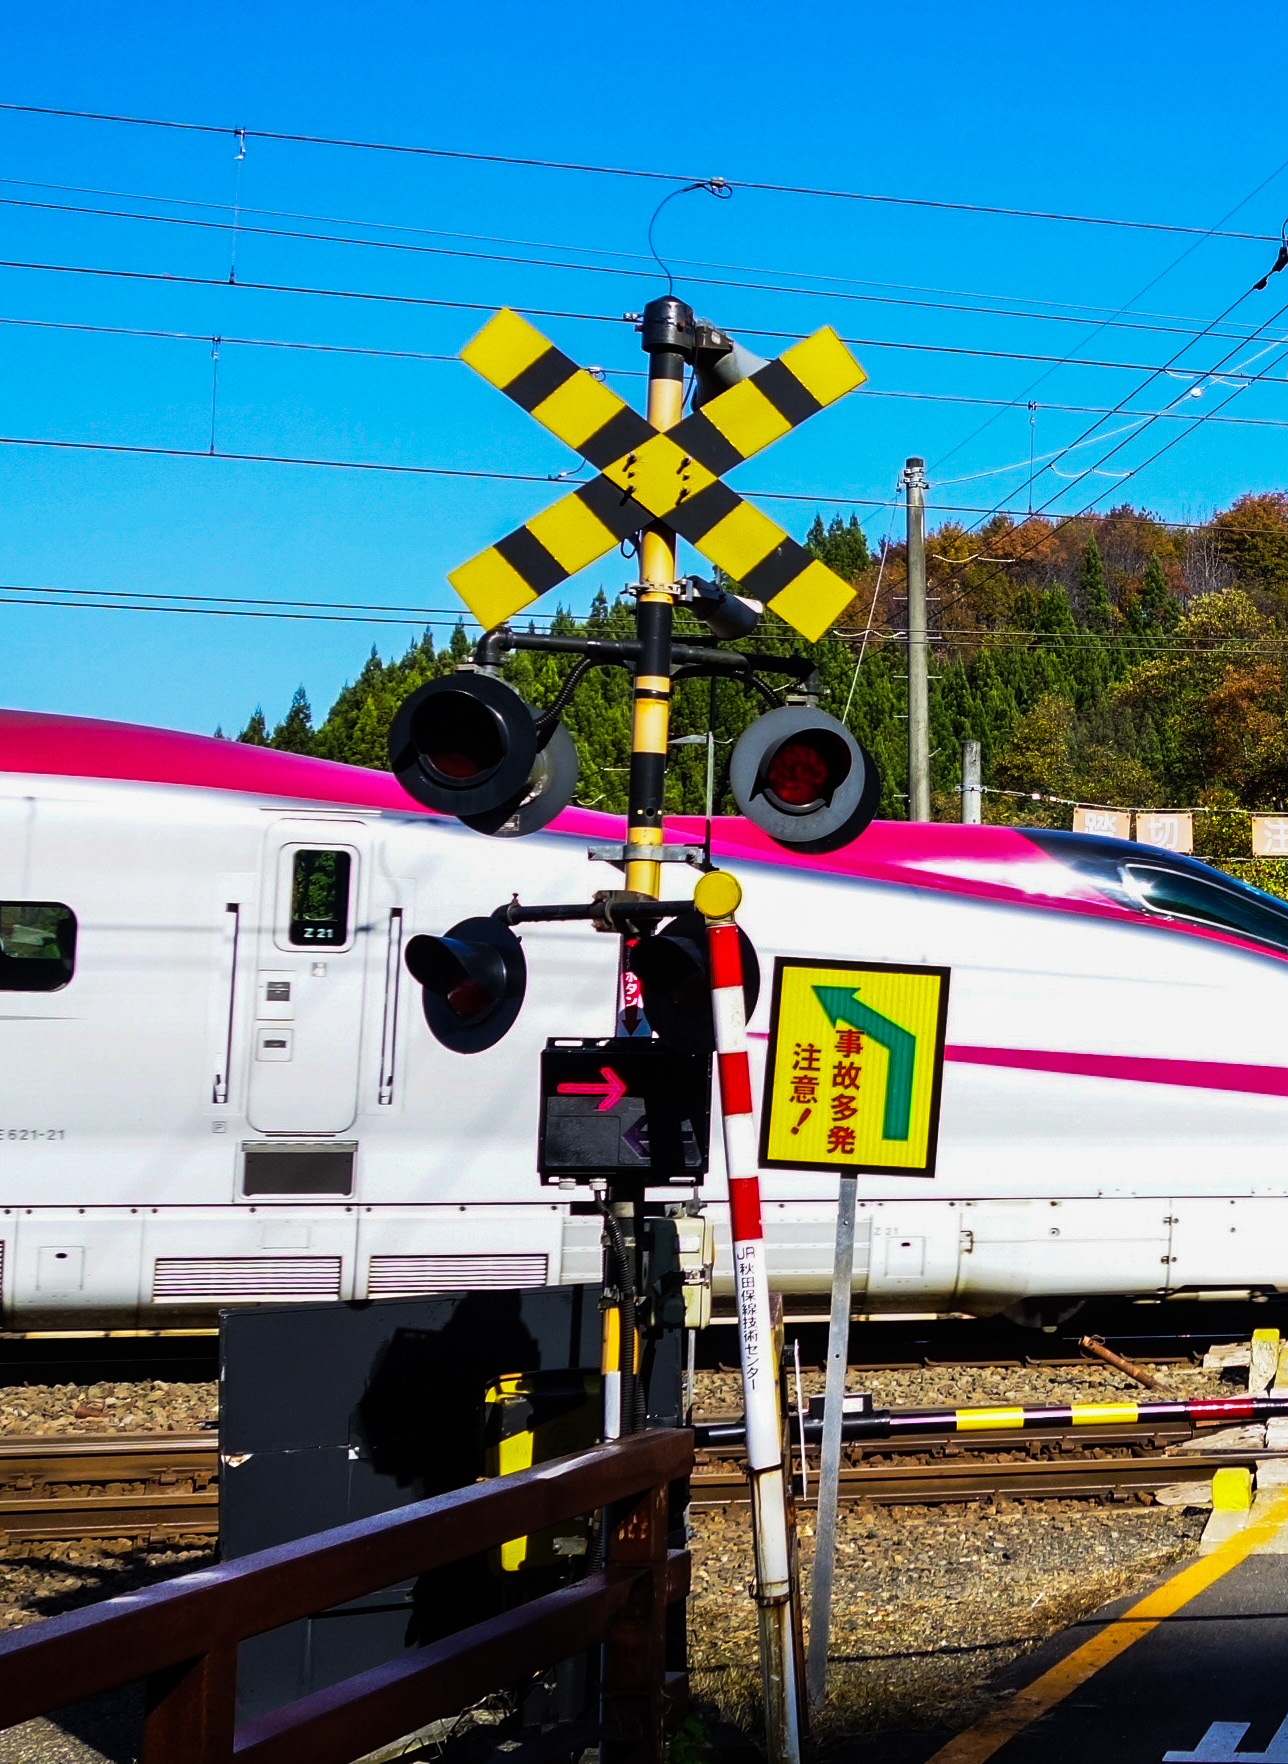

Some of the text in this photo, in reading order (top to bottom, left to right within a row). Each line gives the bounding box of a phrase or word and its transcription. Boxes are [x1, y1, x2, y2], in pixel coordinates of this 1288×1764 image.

[303, 927, 334, 938] Z 21
[826, 1028, 865, 1155] 事故多発
